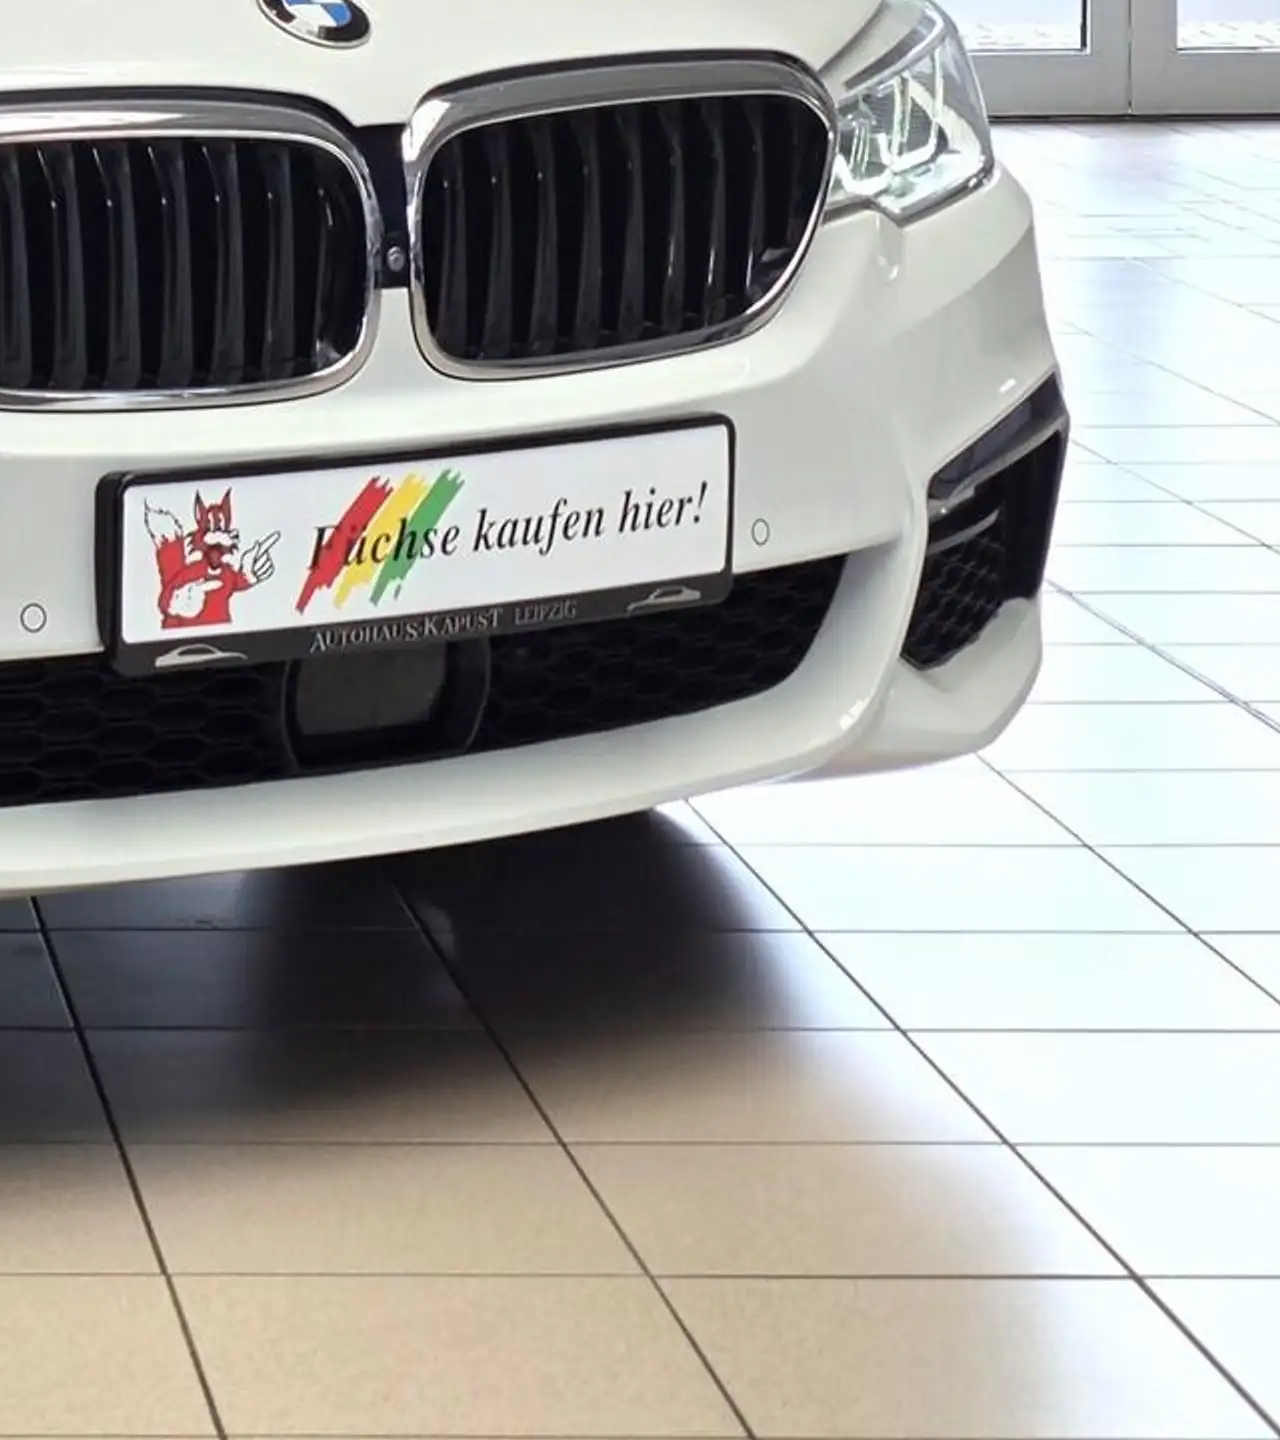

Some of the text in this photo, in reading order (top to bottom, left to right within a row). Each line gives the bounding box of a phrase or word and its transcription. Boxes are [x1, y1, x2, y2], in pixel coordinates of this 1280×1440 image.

[472, 497, 607, 556] kaufen
[618, 480, 708, 534] hier!
[514, 600, 578, 626] LEIPZIG
